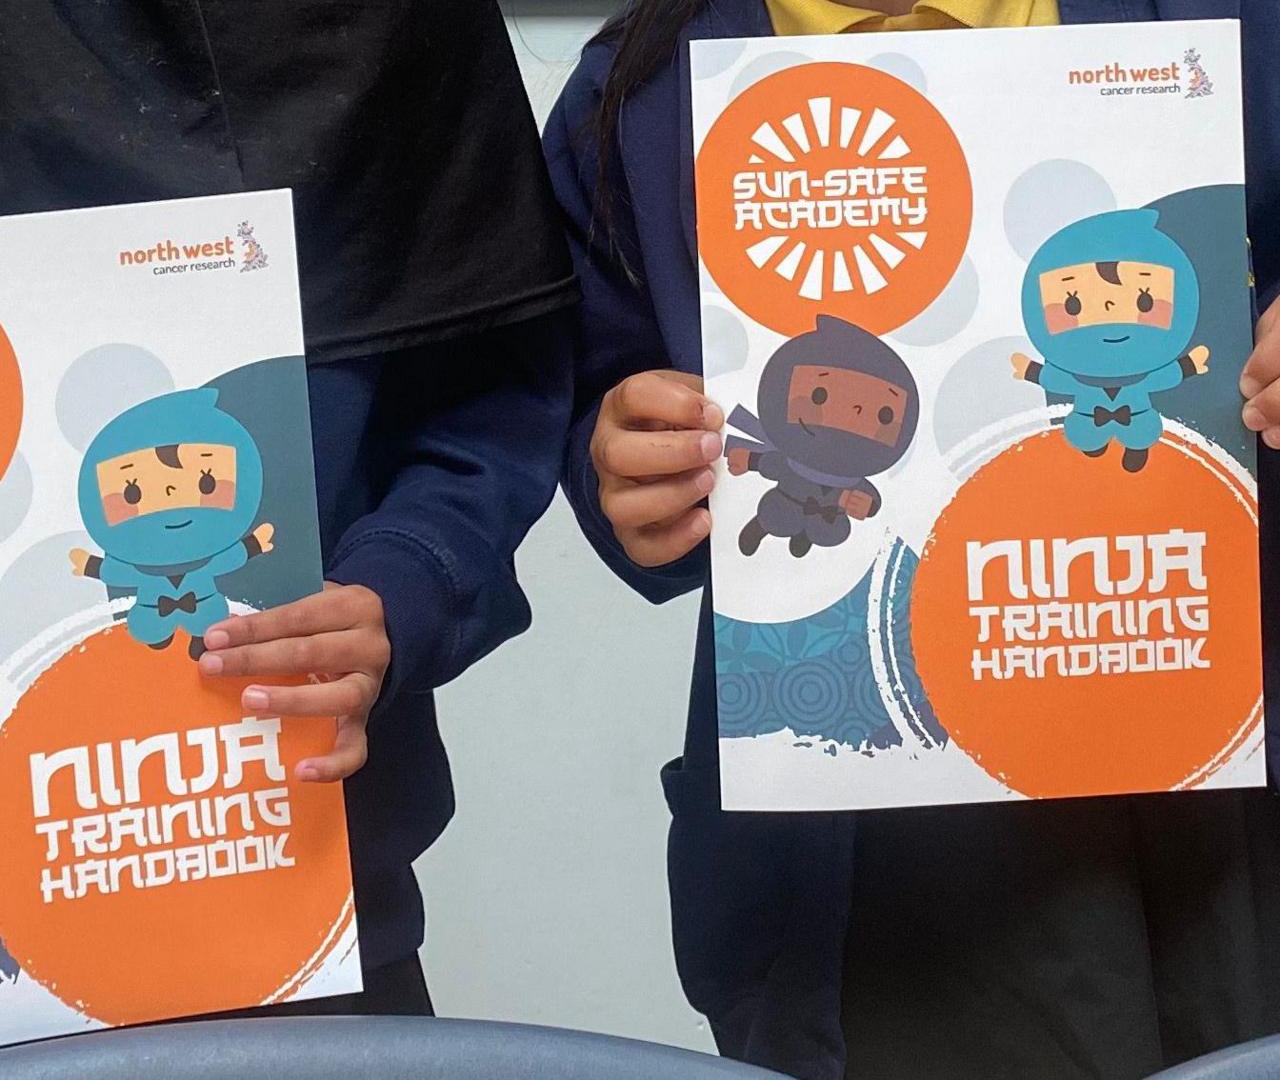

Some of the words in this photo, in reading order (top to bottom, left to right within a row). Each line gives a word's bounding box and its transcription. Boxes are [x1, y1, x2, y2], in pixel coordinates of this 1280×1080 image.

[1069, 62, 1126, 84] north
[1129, 62, 1180, 82] west
[1100, 86, 1134, 96] cancer
[1136, 83, 1181, 95] research
[732, 165, 928, 200] SUN-SAFE
[734, 196, 928, 230] ACADEMY
[120, 239, 180, 266] north
[182, 236, 235, 259] west
[153, 264, 188, 275] cancer
[191, 257, 236, 272] research
[966, 528, 1208, 601] NINJA
[968, 595, 1210, 643] TRAINING
[971, 637, 1211, 681] HANDBOOK
[29, 716, 286, 818] NINJA
[35, 787, 292, 862] TRAINING
[40, 833, 296, 904] HANDBOOK
